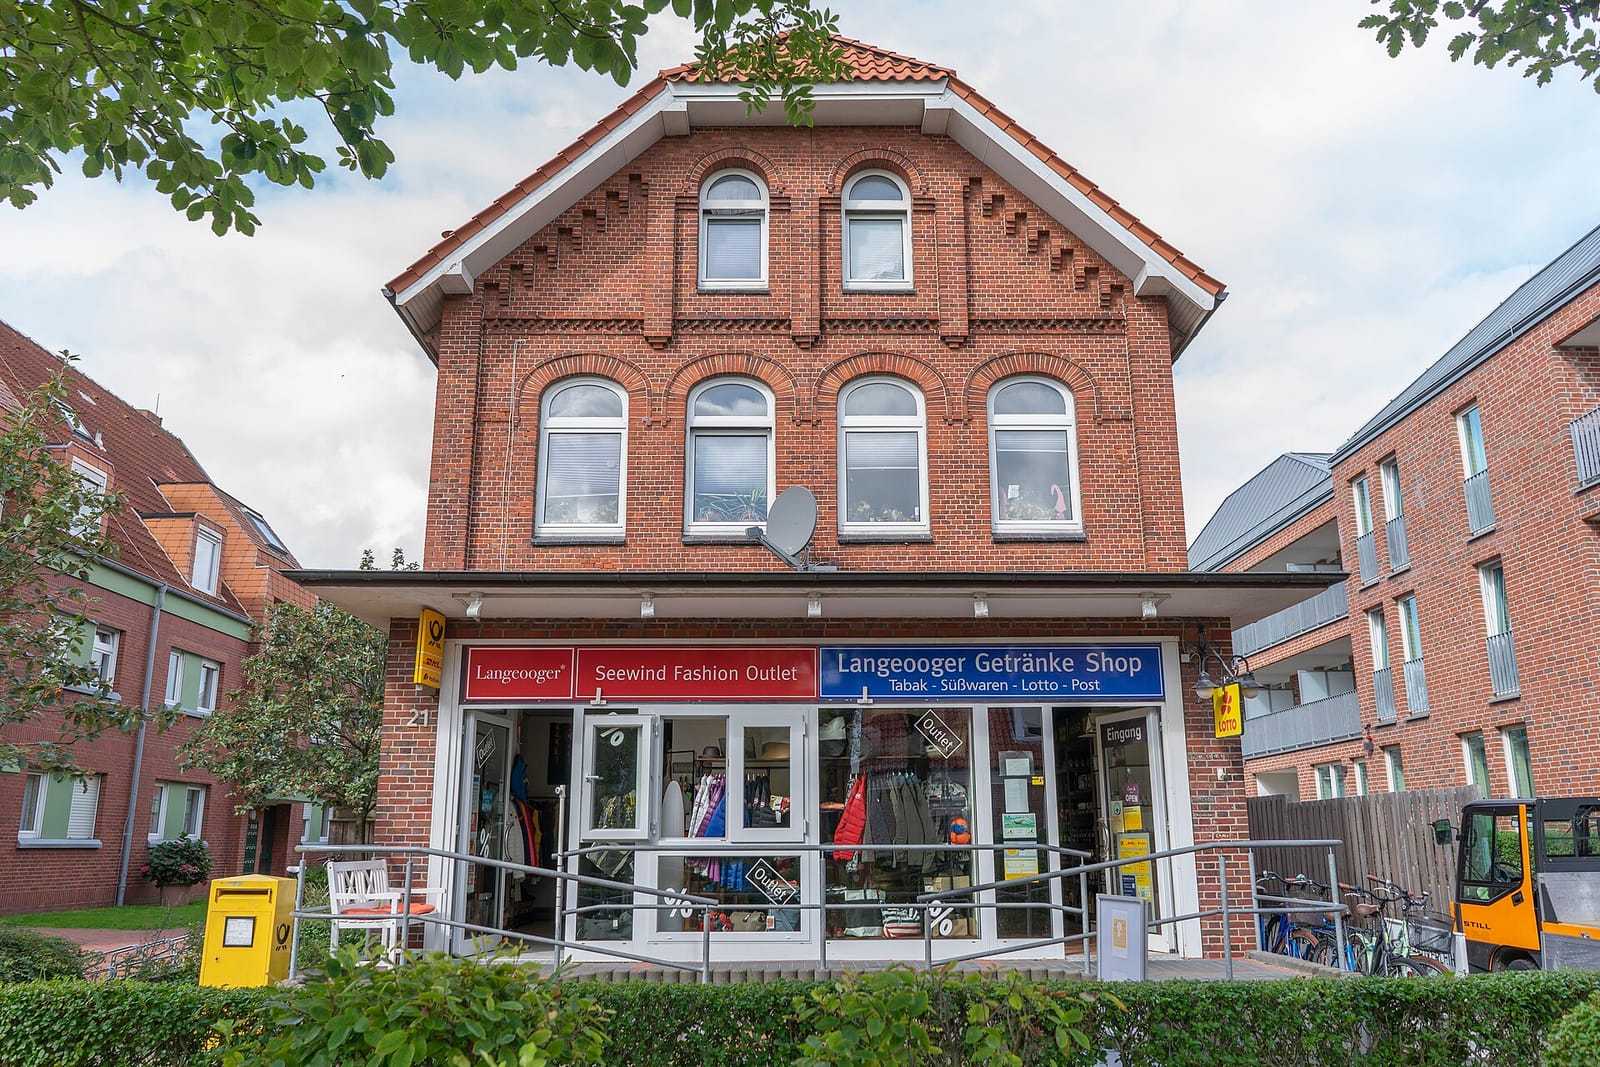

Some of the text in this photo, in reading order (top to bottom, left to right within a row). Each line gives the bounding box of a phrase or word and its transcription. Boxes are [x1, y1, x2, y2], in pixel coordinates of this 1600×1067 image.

[425, 657, 440, 669] DHL
[838, 650, 1142, 677] Langeooger Getränke Shop
[595, 665, 798, 681] Seewind Fashion Outlet
[889, 679, 928, 691] Tabak
[941, 678, 1008, 691] Süßwaren
[1022, 679, 1059, 691] Lotto
[1072, 679, 1101, 691] Post
[407, 709, 430, 727] 21
[1218, 719, 1237, 732] LOTTO
[922, 717, 954, 751] Outlet
[1106, 725, 1142, 742] Eingang
[479, 738, 494, 761] Outlet
[1125, 794, 1139, 802] OPEN
[754, 867, 788, 901] Outlet
[1464, 920, 1492, 930] STILL
